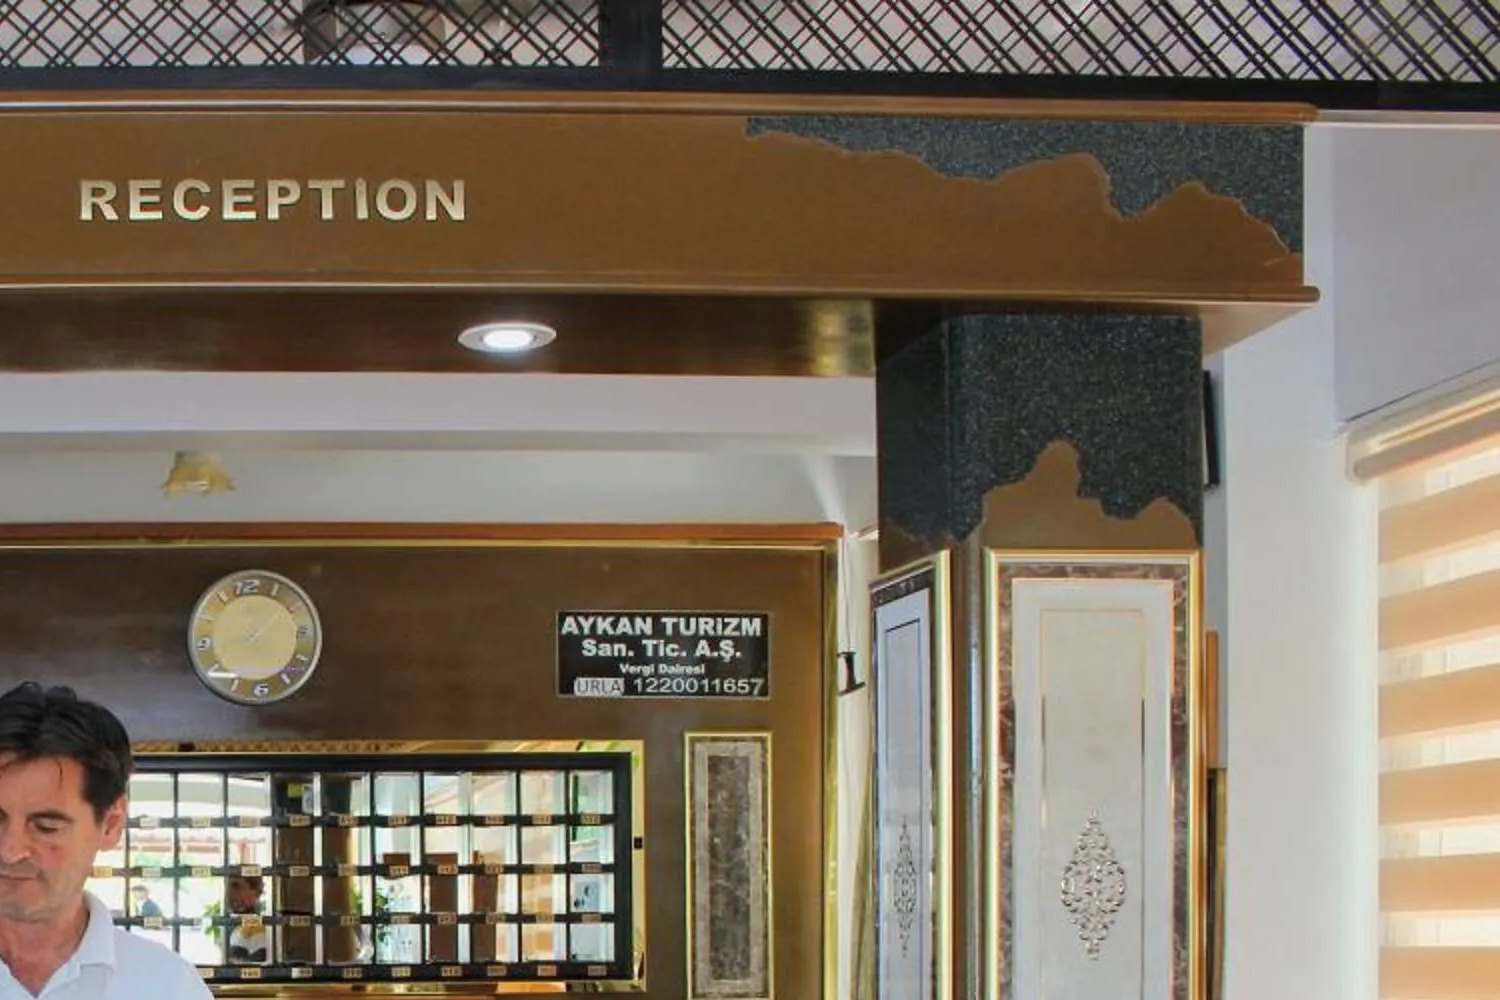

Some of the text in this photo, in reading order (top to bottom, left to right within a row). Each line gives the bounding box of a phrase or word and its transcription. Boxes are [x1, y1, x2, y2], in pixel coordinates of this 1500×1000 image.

[78, 177, 468, 222] RECEPTION
[561, 616, 653, 637] AYKAN
[581, 639, 634, 657] San.
[641, 639, 687, 657] Tic.
[619, 663, 655, 676] Vergi
[633, 678, 764, 695] 1220011657
